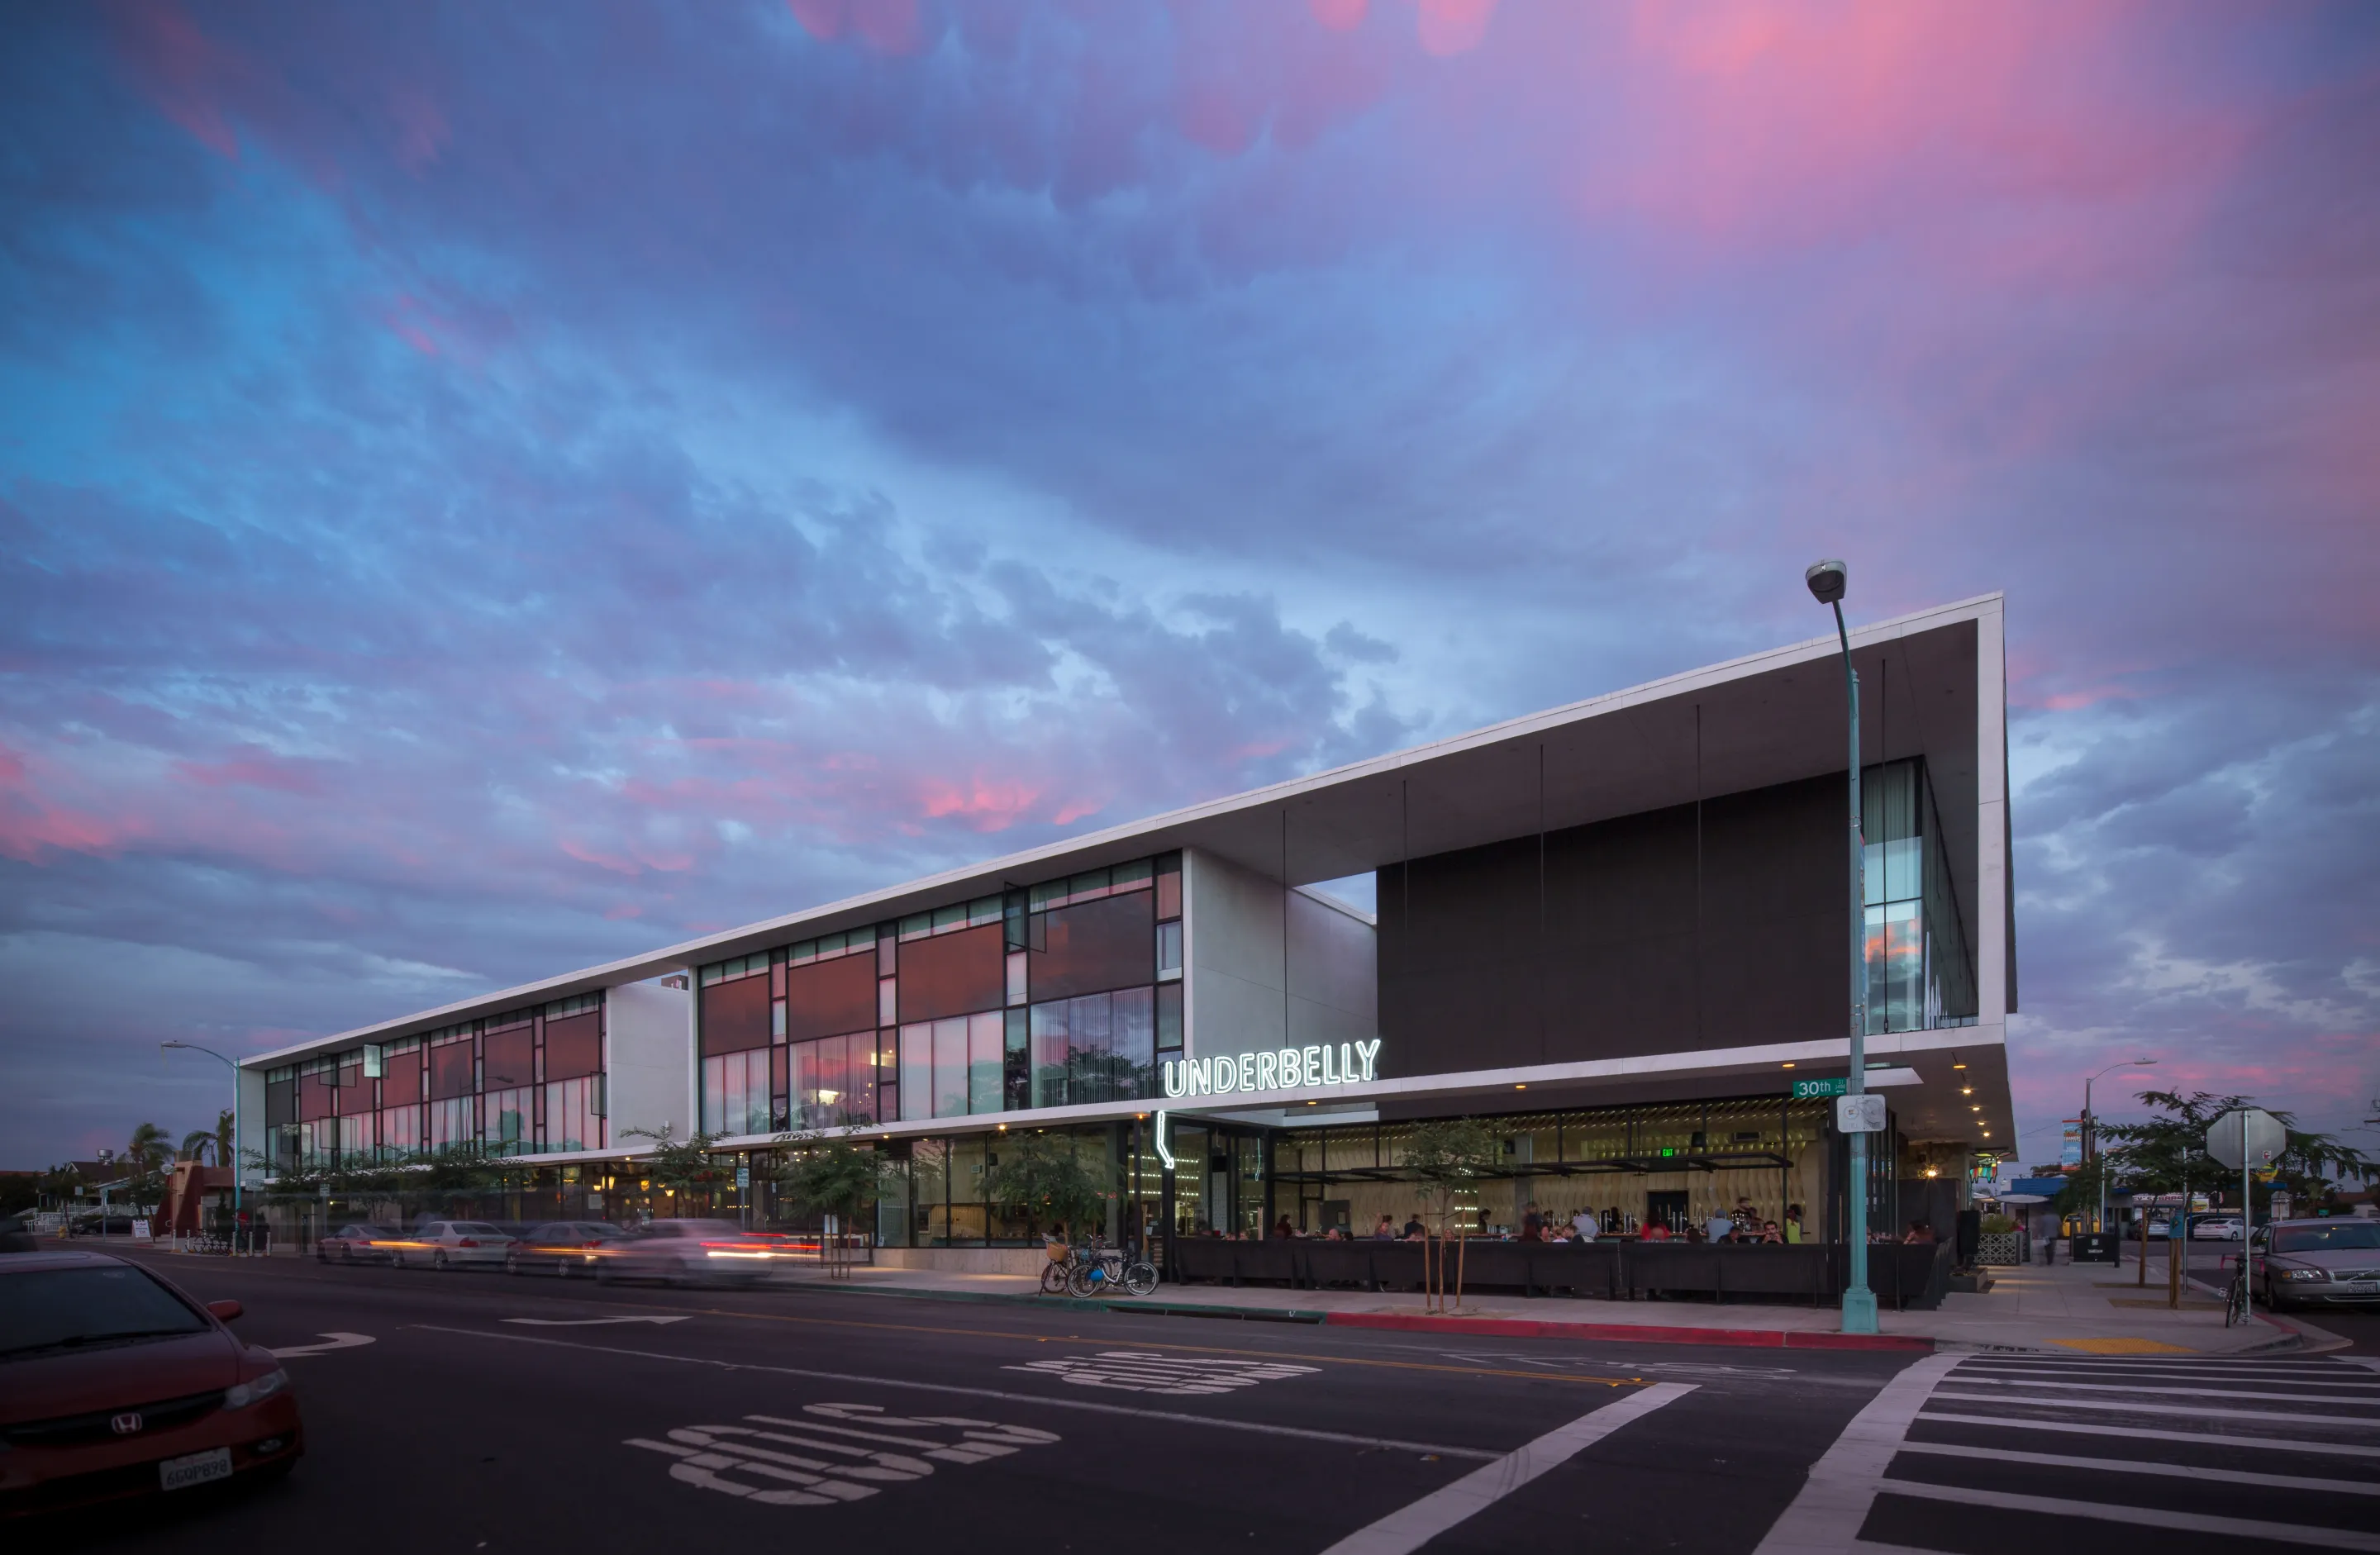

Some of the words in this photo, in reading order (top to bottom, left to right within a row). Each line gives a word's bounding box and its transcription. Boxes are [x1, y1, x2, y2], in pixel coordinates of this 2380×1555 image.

[1164, 1039, 1381, 1098] UNDERBELLY
[1798, 1081, 1831, 1096] 30th
[1663, 1148, 1673, 1157] EXIT
